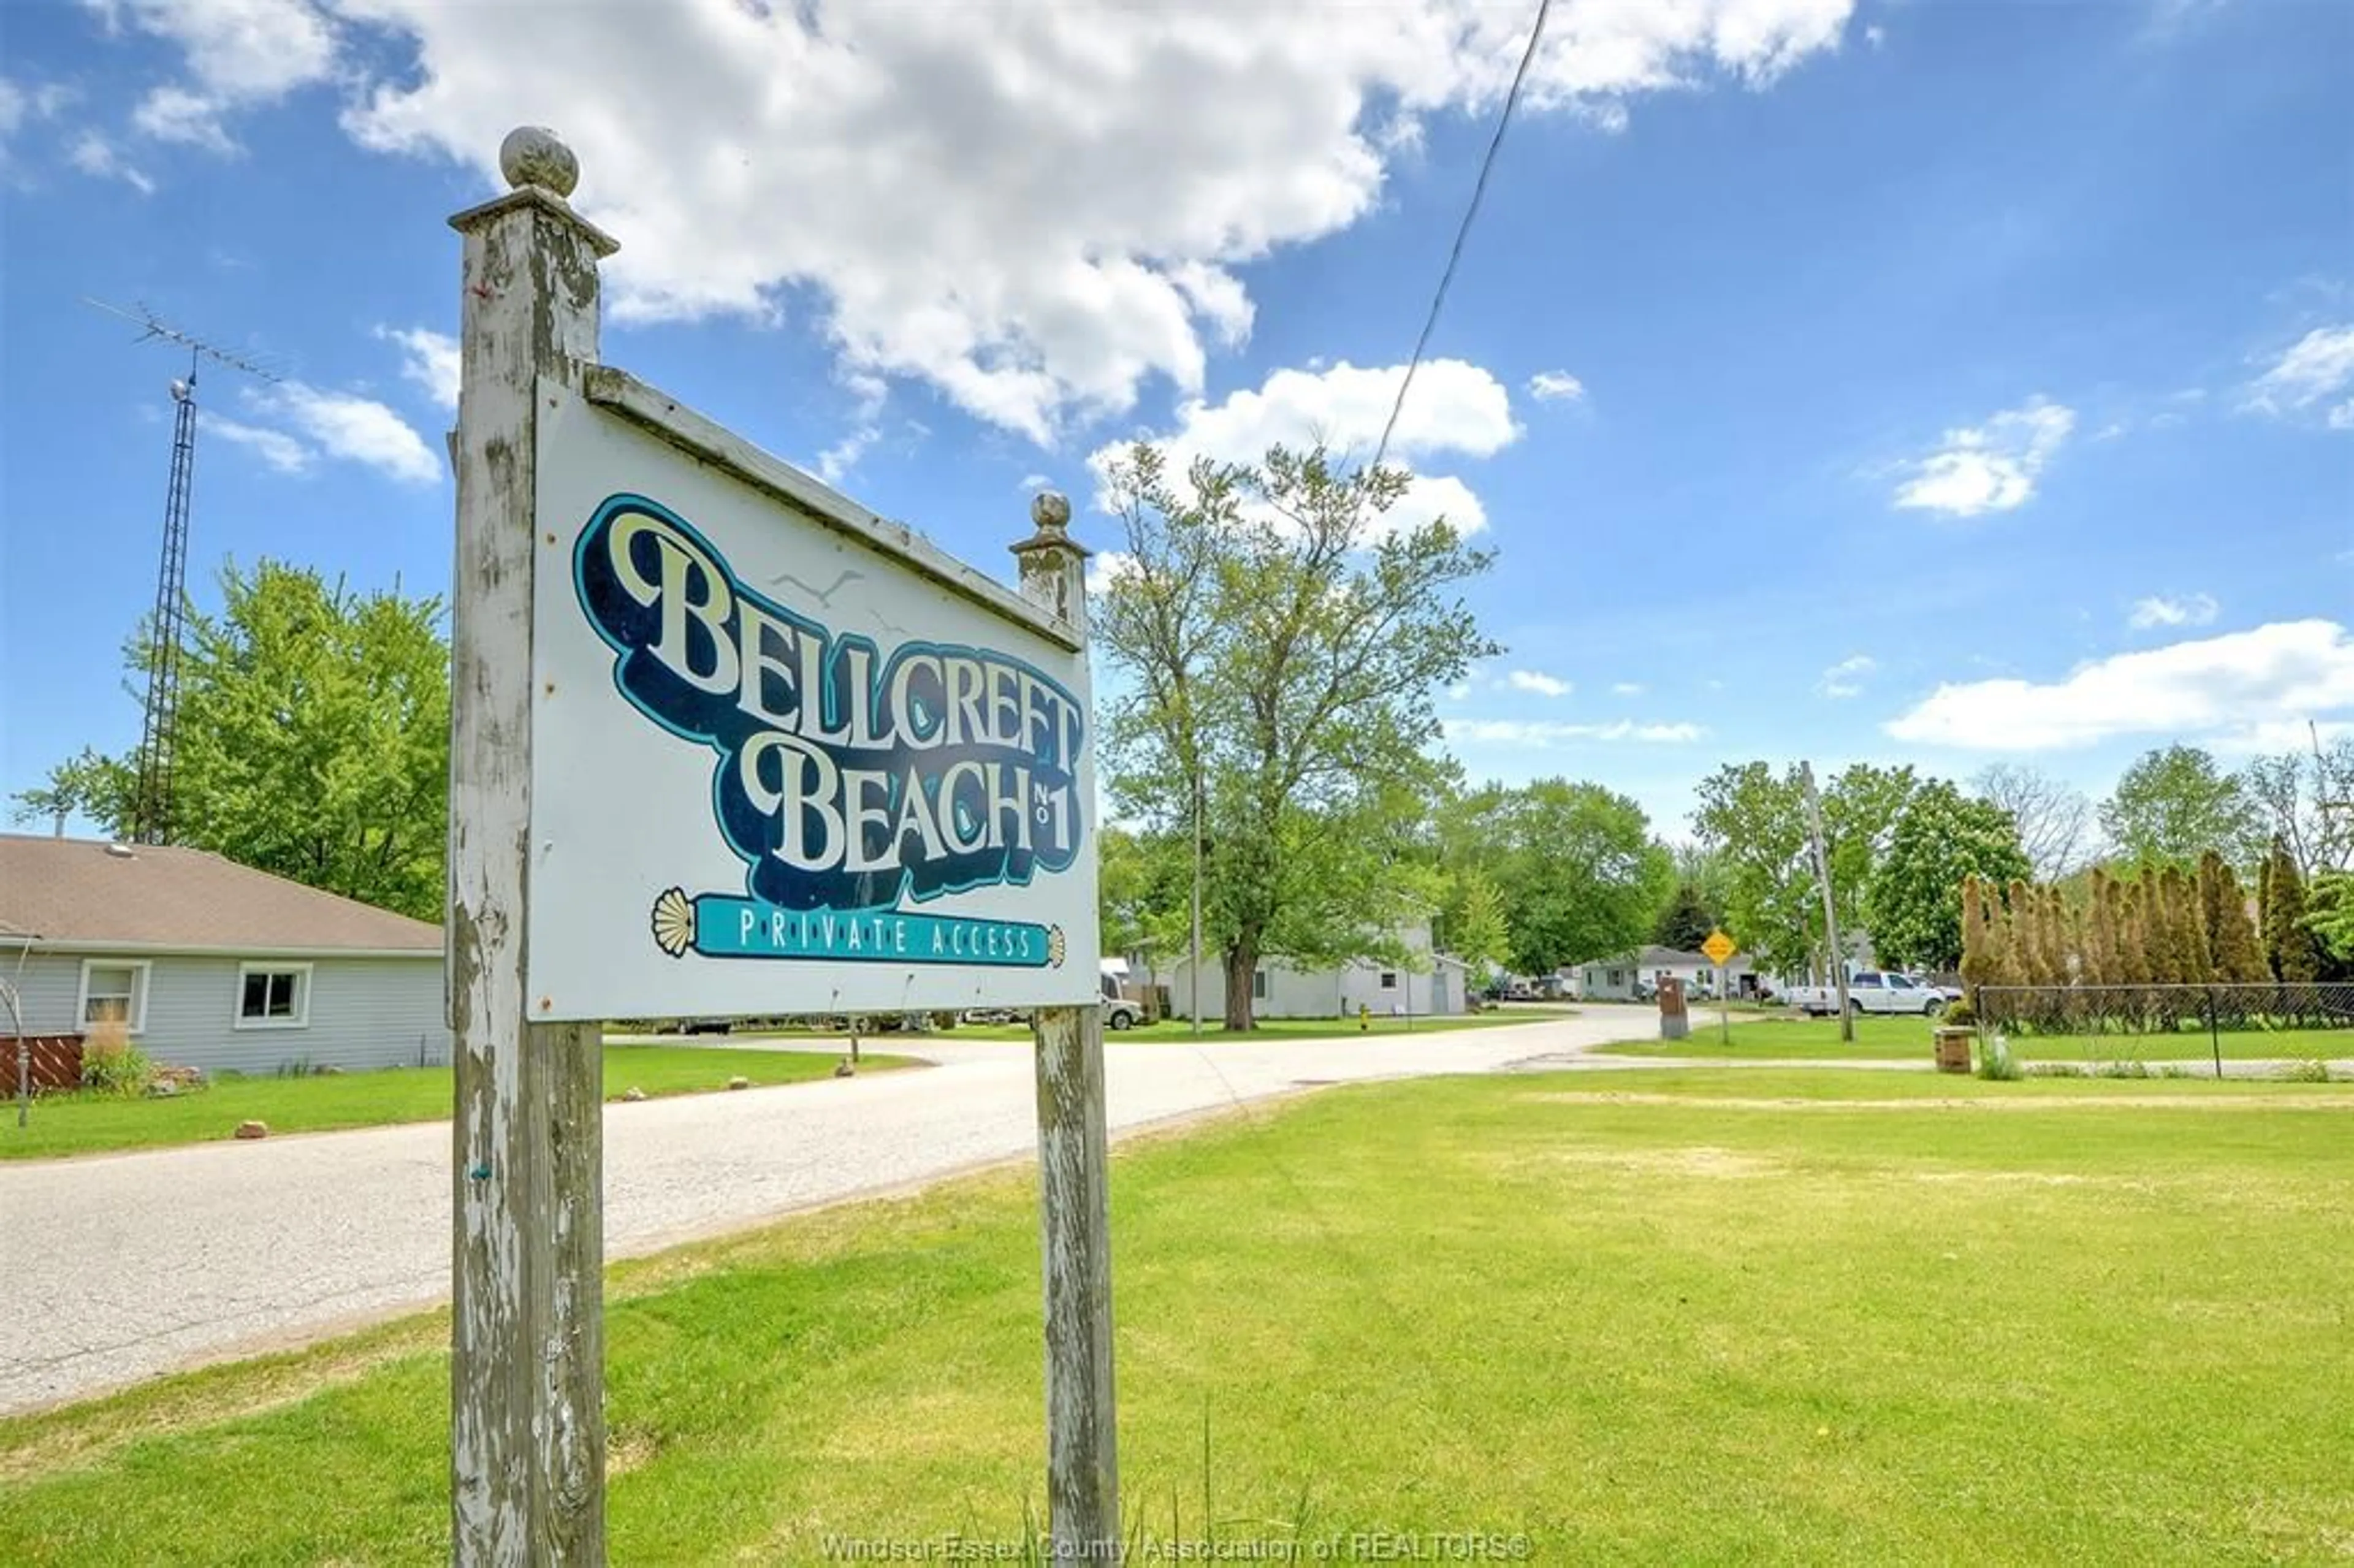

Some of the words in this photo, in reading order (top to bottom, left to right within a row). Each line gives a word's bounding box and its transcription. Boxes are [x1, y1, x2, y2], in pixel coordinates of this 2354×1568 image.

[609, 512, 1080, 777] BELLCREFT
[740, 735, 1034, 873] BEACH
[1049, 785, 1070, 851] 1
[739, 908, 907, 953] PRIVATE
[931, 923, 1030, 957] ACCESS
